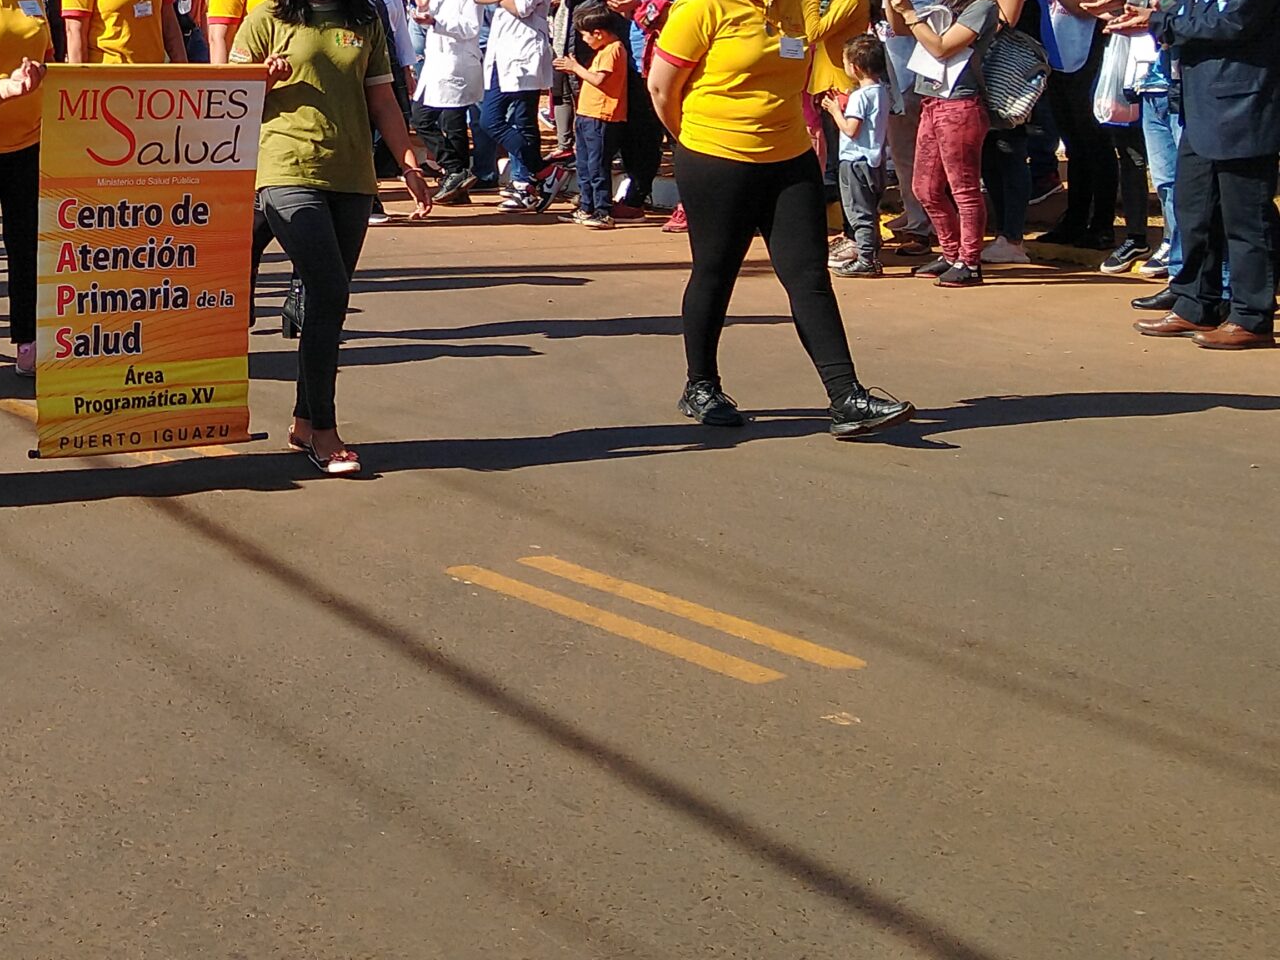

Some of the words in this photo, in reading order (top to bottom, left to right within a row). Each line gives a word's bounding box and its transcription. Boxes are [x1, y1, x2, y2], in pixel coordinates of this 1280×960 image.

[58, 86, 248, 121] MISIONES
[86, 86, 241, 167] Salud
[97, 178, 133, 186] Ministerio
[136, 178, 146, 186] de
[147, 177, 170, 185] Salud
[57, 198, 163, 230] Centro
[170, 193, 210, 226] de
[56, 236, 197, 273] Atención
[57, 278, 189, 316] Primaria
[196, 291, 216, 309] de
[219, 290, 235, 308] la
[55, 321, 142, 359] Salud
[125, 365, 164, 385] Área
[74, 390, 188, 415] Programática
[191, 387, 215, 404] XV
[59, 431, 142, 450] PUERTO
[154, 425, 230, 443] IGUAZU
